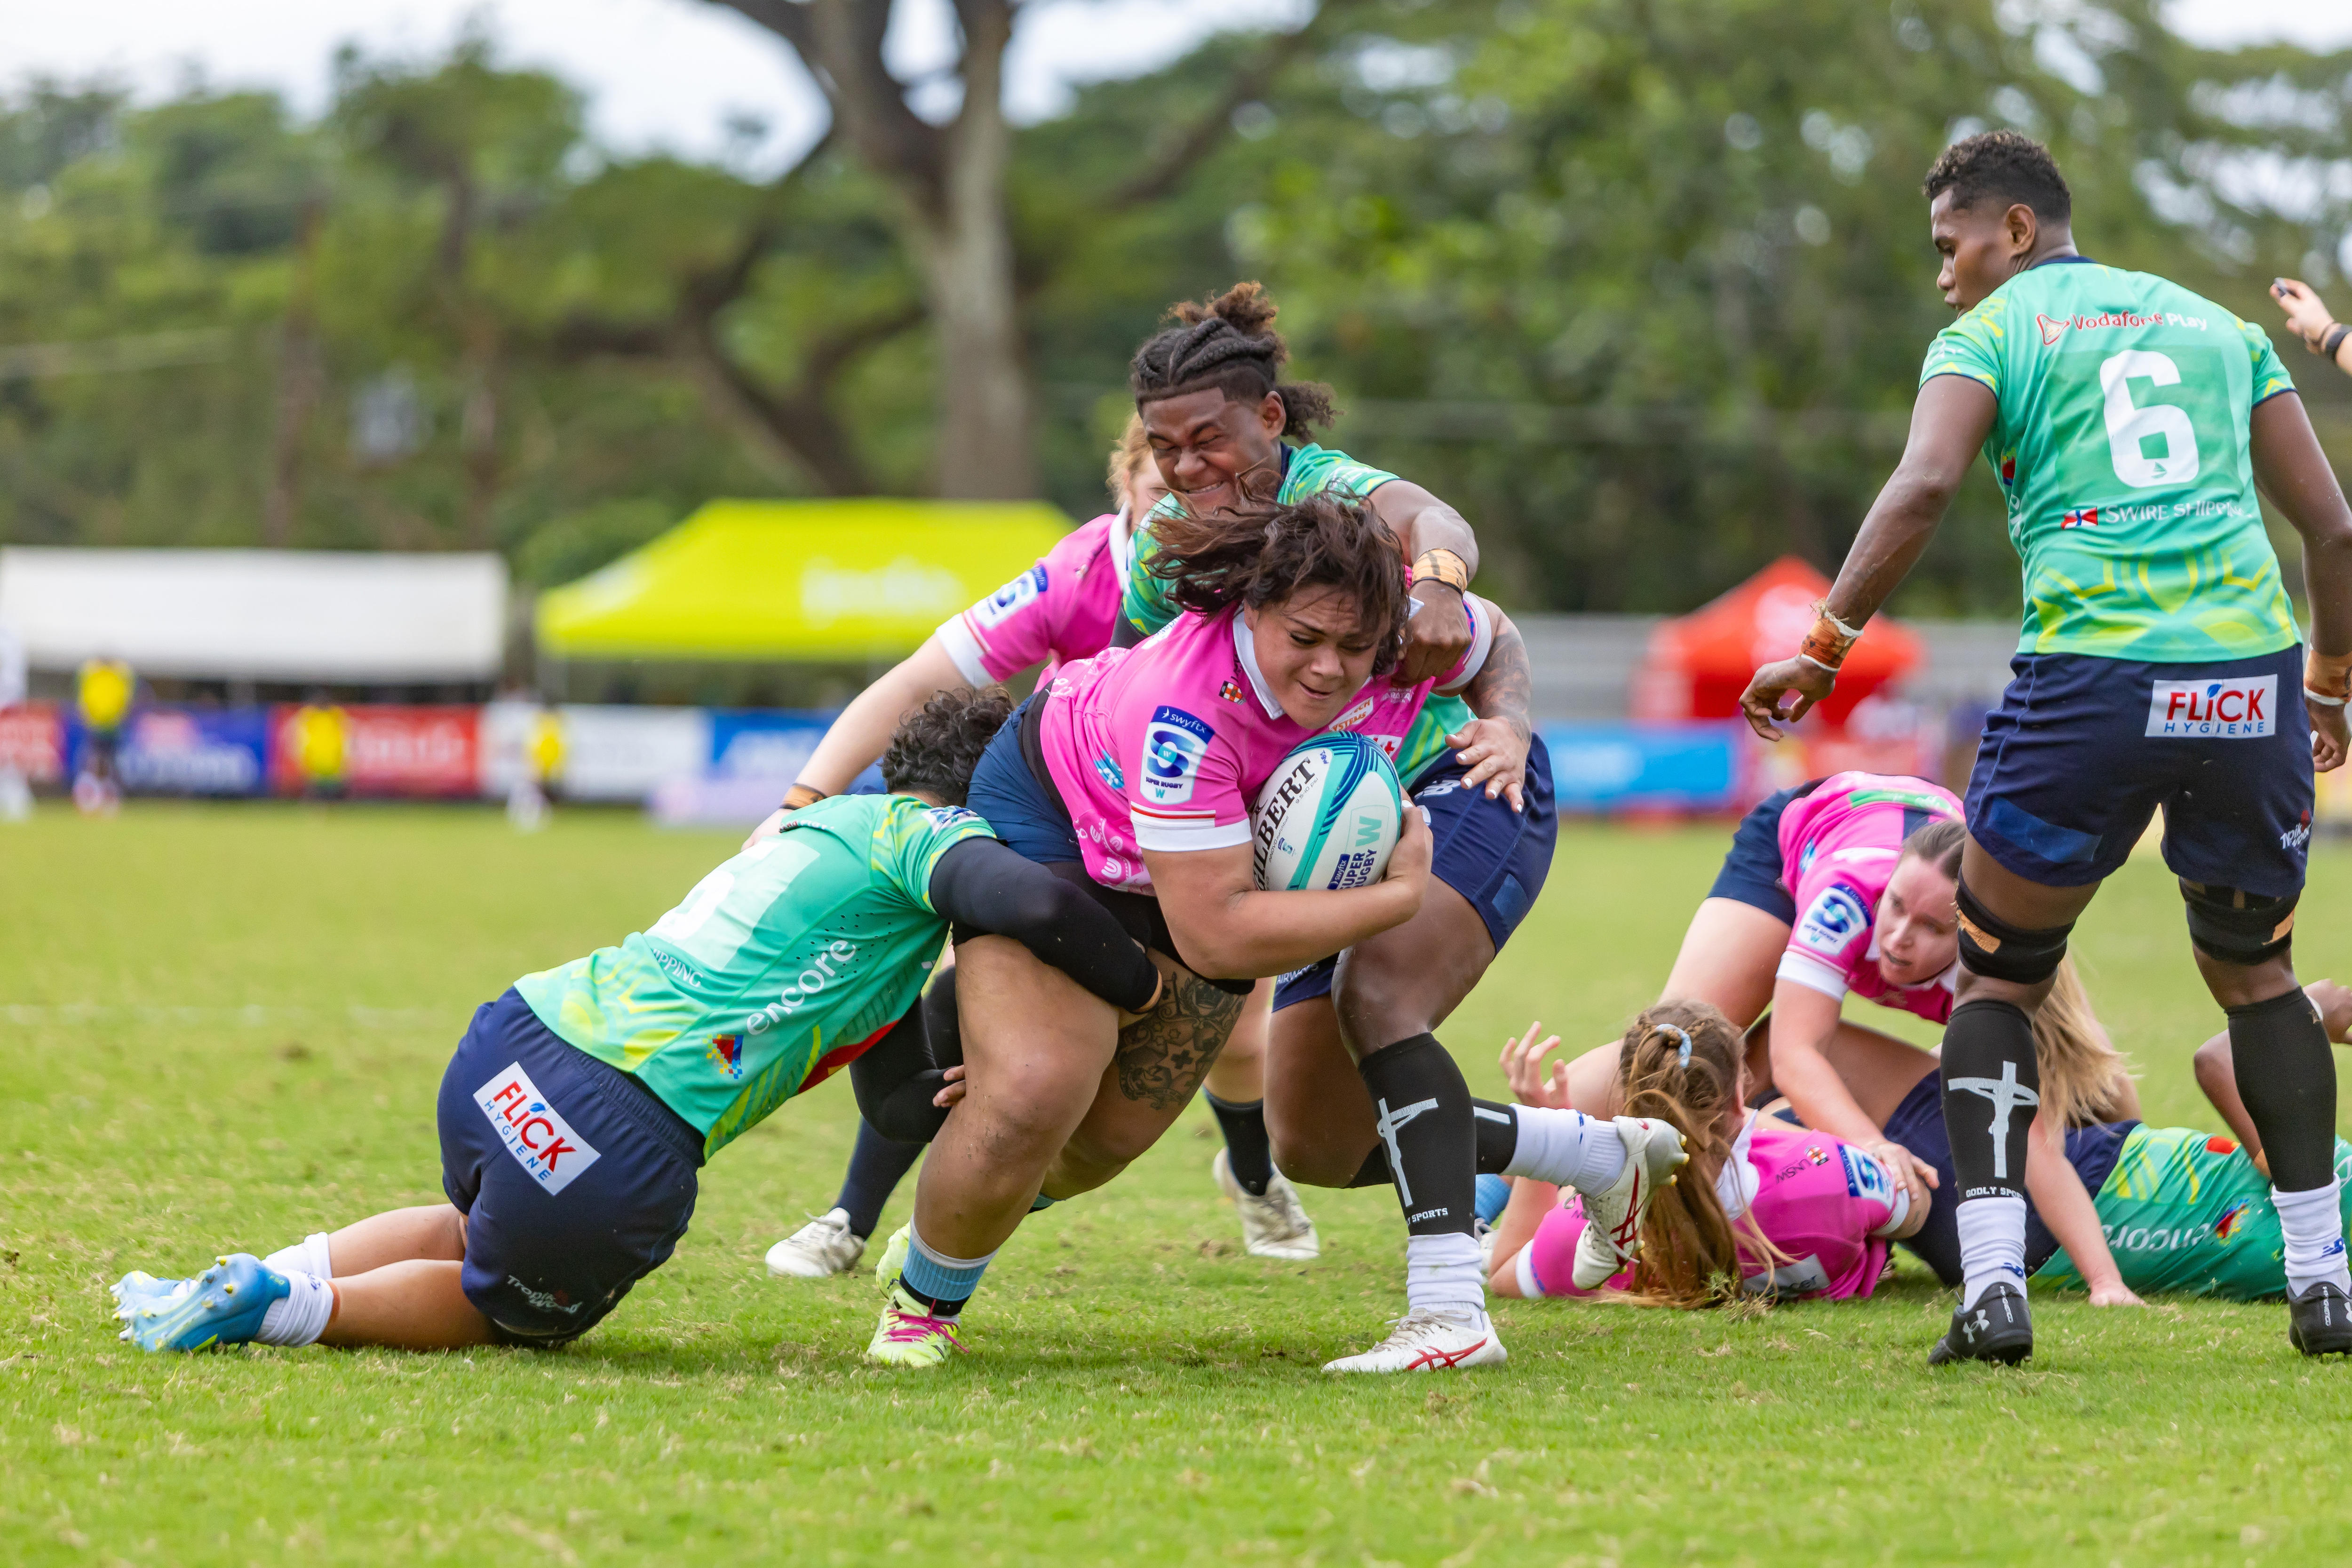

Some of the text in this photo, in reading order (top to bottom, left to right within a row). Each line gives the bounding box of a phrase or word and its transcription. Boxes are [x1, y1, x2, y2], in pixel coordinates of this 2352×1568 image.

[2072, 310, 2207, 331] Vodafone Play
[2099, 350, 2199, 488] 6
[2105, 500, 2253, 523] SWIRE SHIPPIN
[1170, 713, 1207, 734] swyftx
[2164, 722, 2265, 734] HYGIENE
[1145, 776, 1184, 789] SUPER RUGBY
[1155, 788, 1166, 798] W
[1253, 757, 1315, 891] GILBERT
[1355, 815, 1382, 847] W
[1335, 860, 1347, 881] swyftx
[1353, 849, 1377, 888] UGBY
[653, 948, 703, 987] IPPING
[747, 940, 856, 1035] encore
[484, 1100, 553, 1182] HYGIENE
[1776, 1159, 1811, 1184] UNSW
[1966, 1186, 1997, 1198] GODLY
[1411, 1208, 1448, 1223] SPORTS
